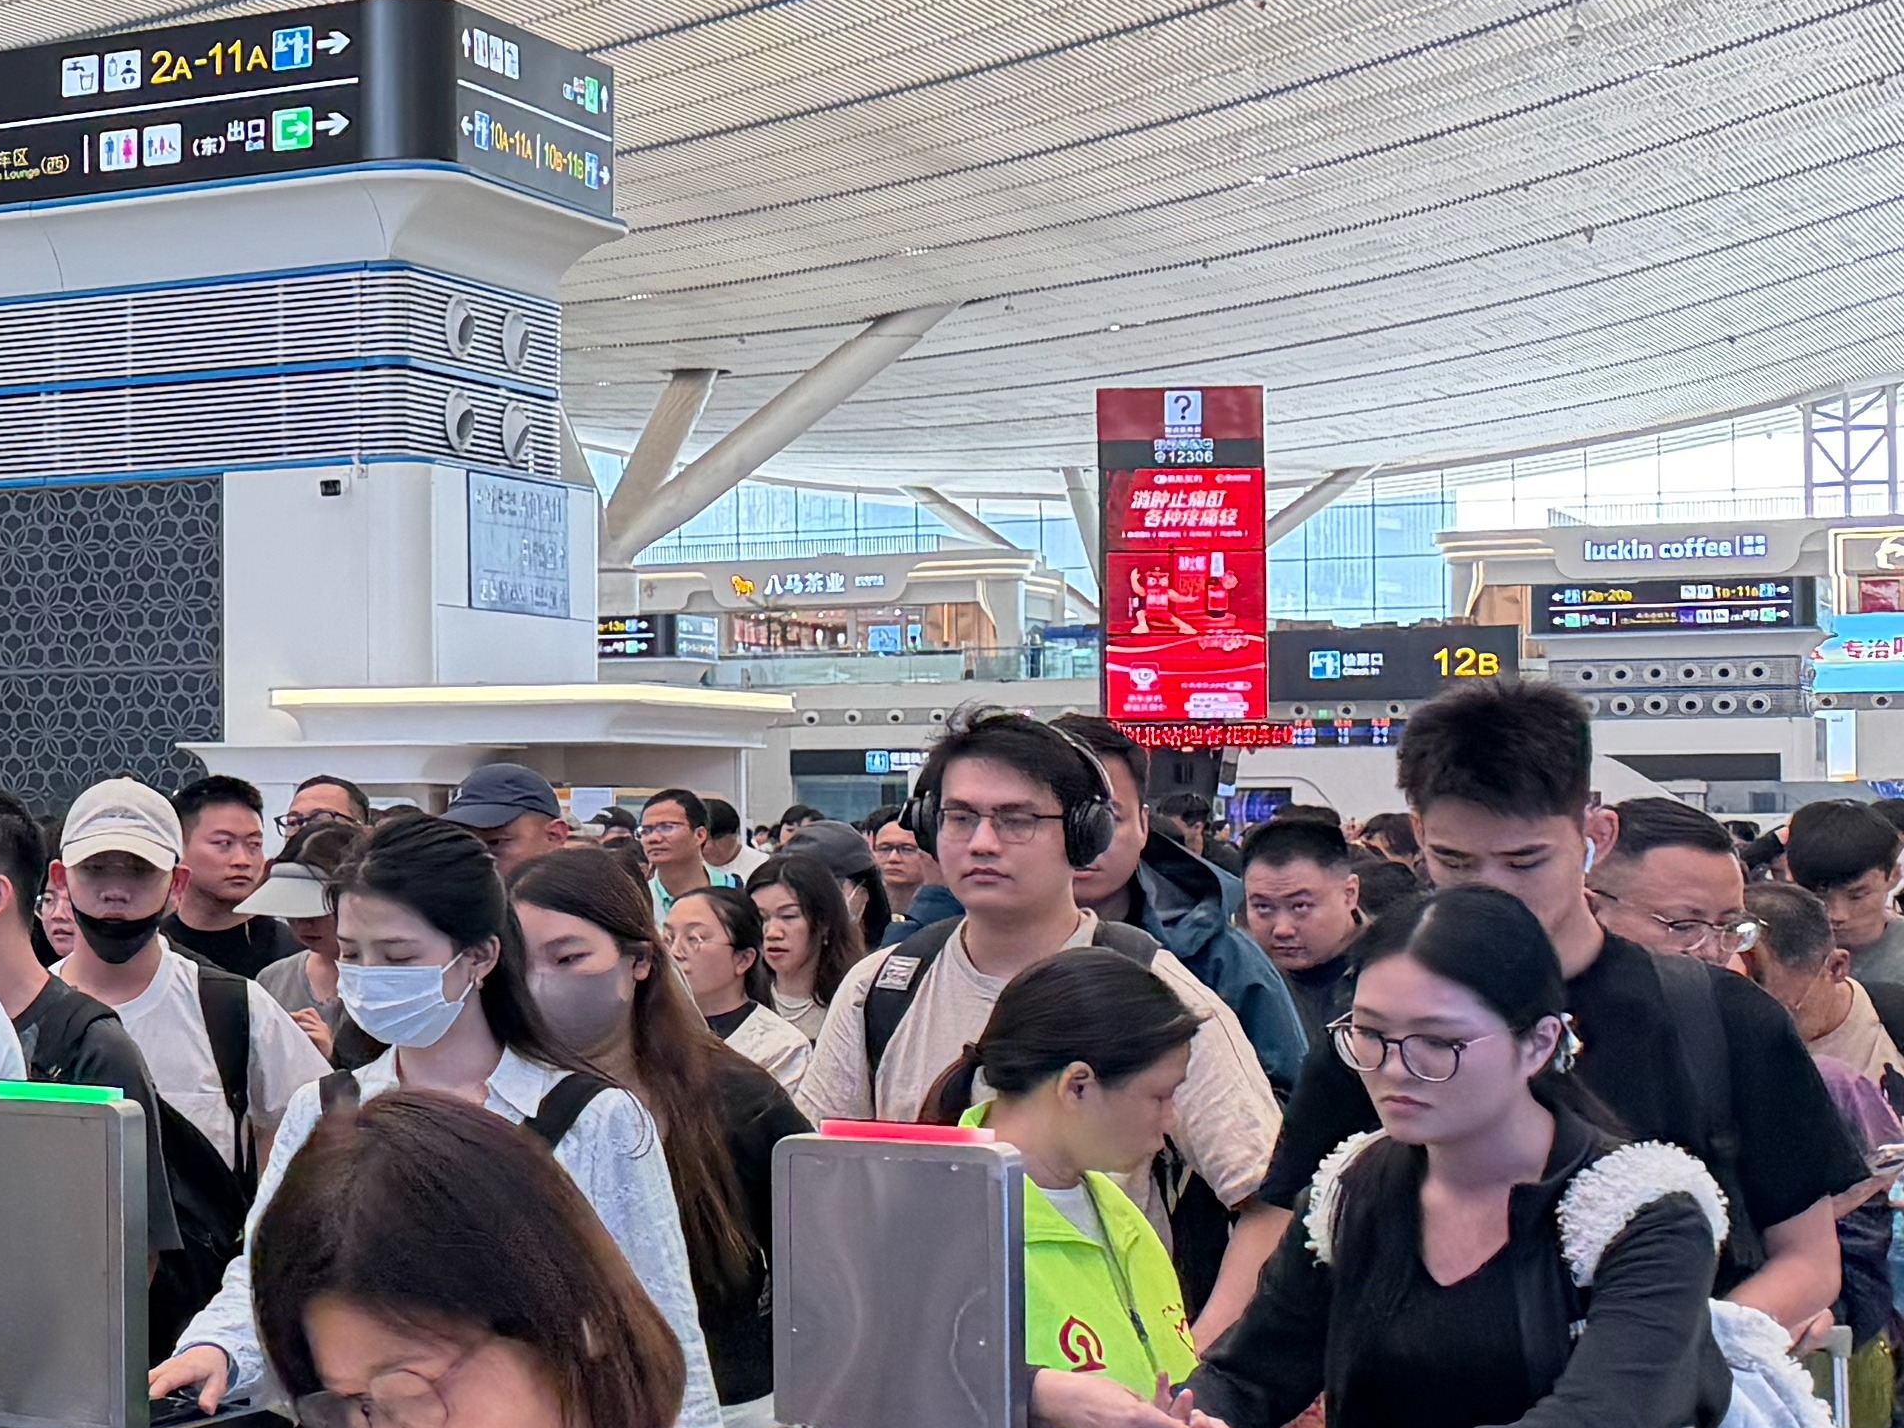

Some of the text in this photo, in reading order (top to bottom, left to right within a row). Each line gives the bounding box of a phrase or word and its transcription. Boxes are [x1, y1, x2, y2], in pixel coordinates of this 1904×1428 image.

[150, 39, 268, 84] 2A-11A
[227, 119, 265, 142] 出口
[1169, 450, 1213, 463] 12306
[1584, 538, 1653, 561] luckin
[1659, 536, 1733, 559] coffee
[764, 572, 845, 594] 八马茶业
[1434, 647, 1499, 676] 12B
